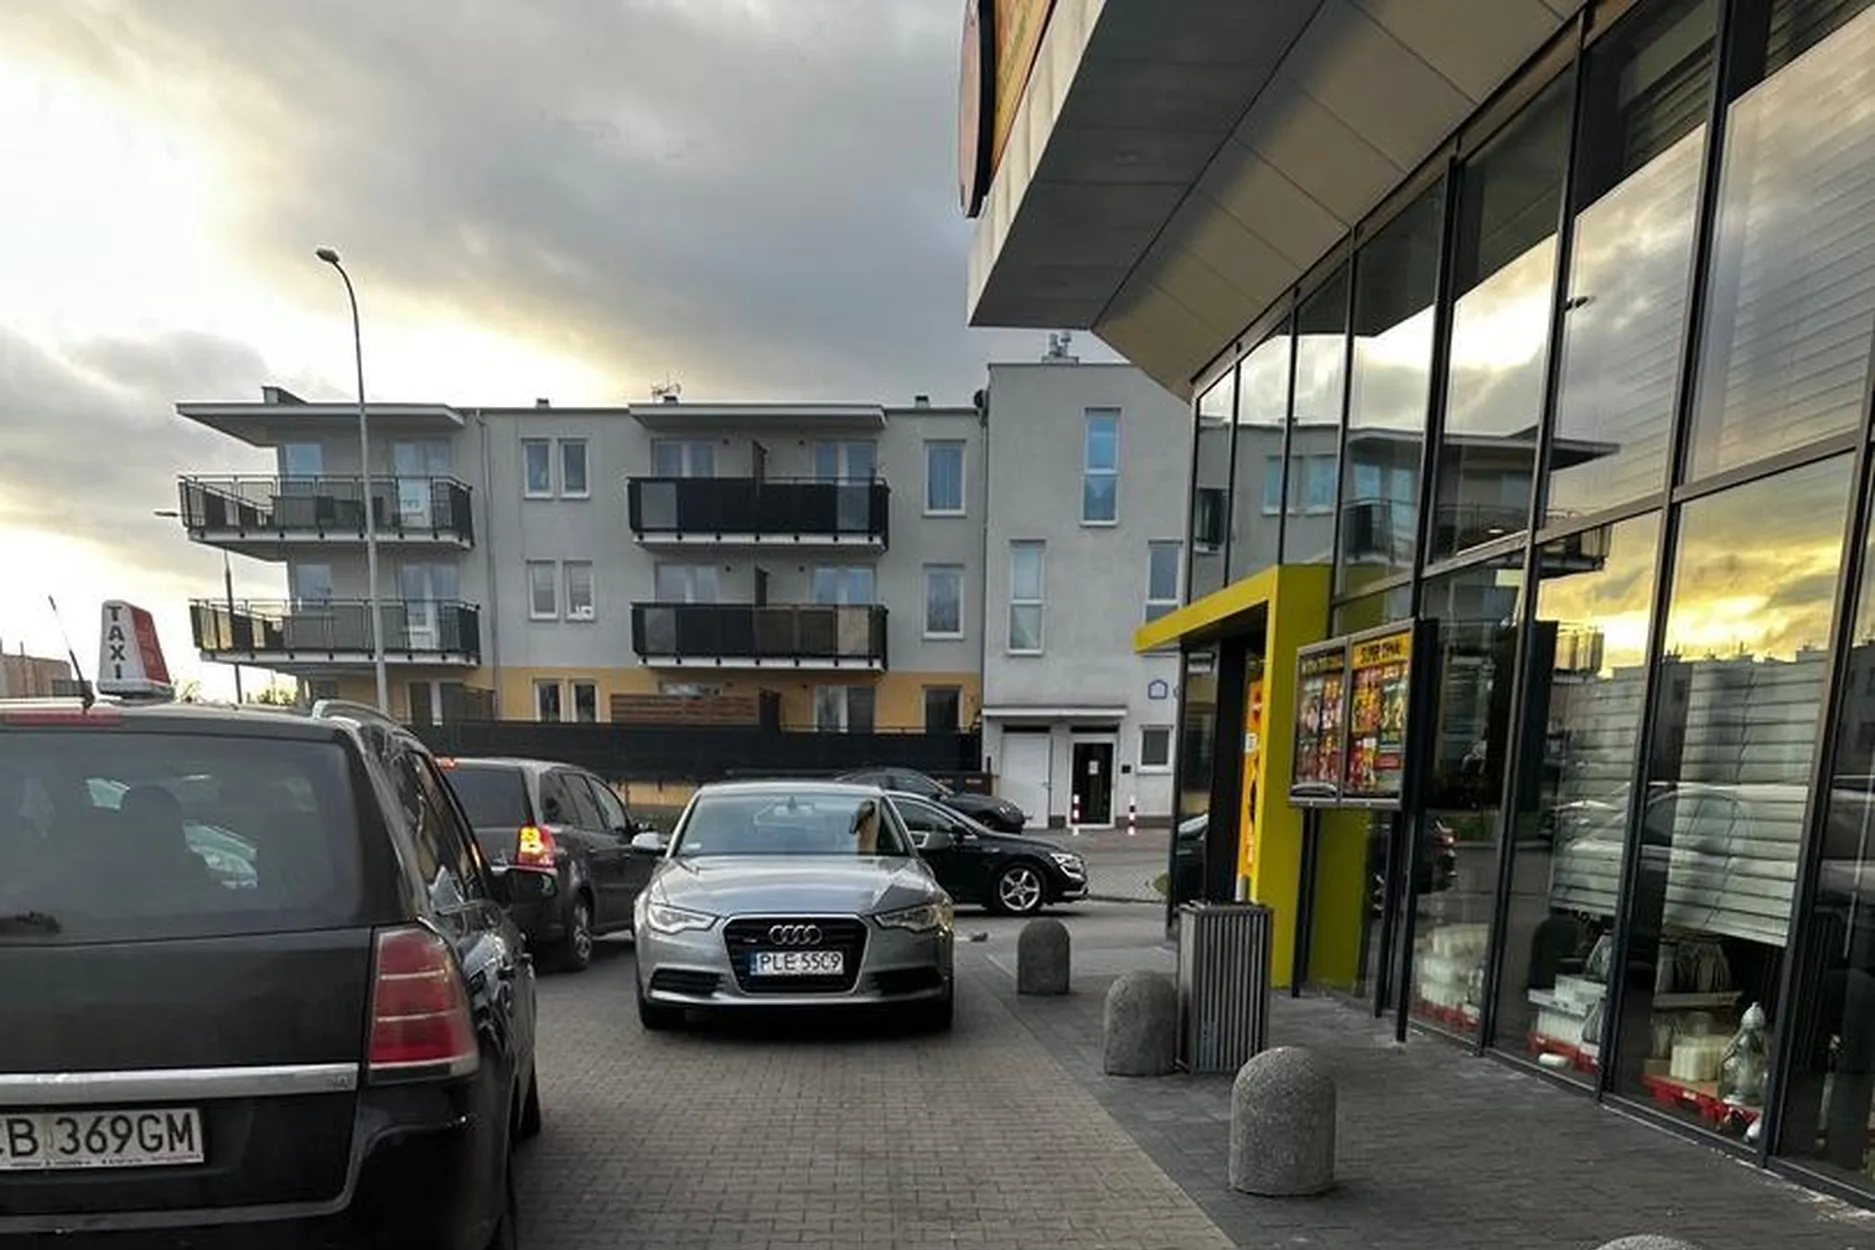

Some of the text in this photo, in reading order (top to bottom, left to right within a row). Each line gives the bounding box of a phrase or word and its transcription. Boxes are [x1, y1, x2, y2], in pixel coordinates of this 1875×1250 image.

[107, 606, 126, 680] TAXI
[760, 953, 796, 971] PLE
[0, 1112, 196, 1157] B 369GM
